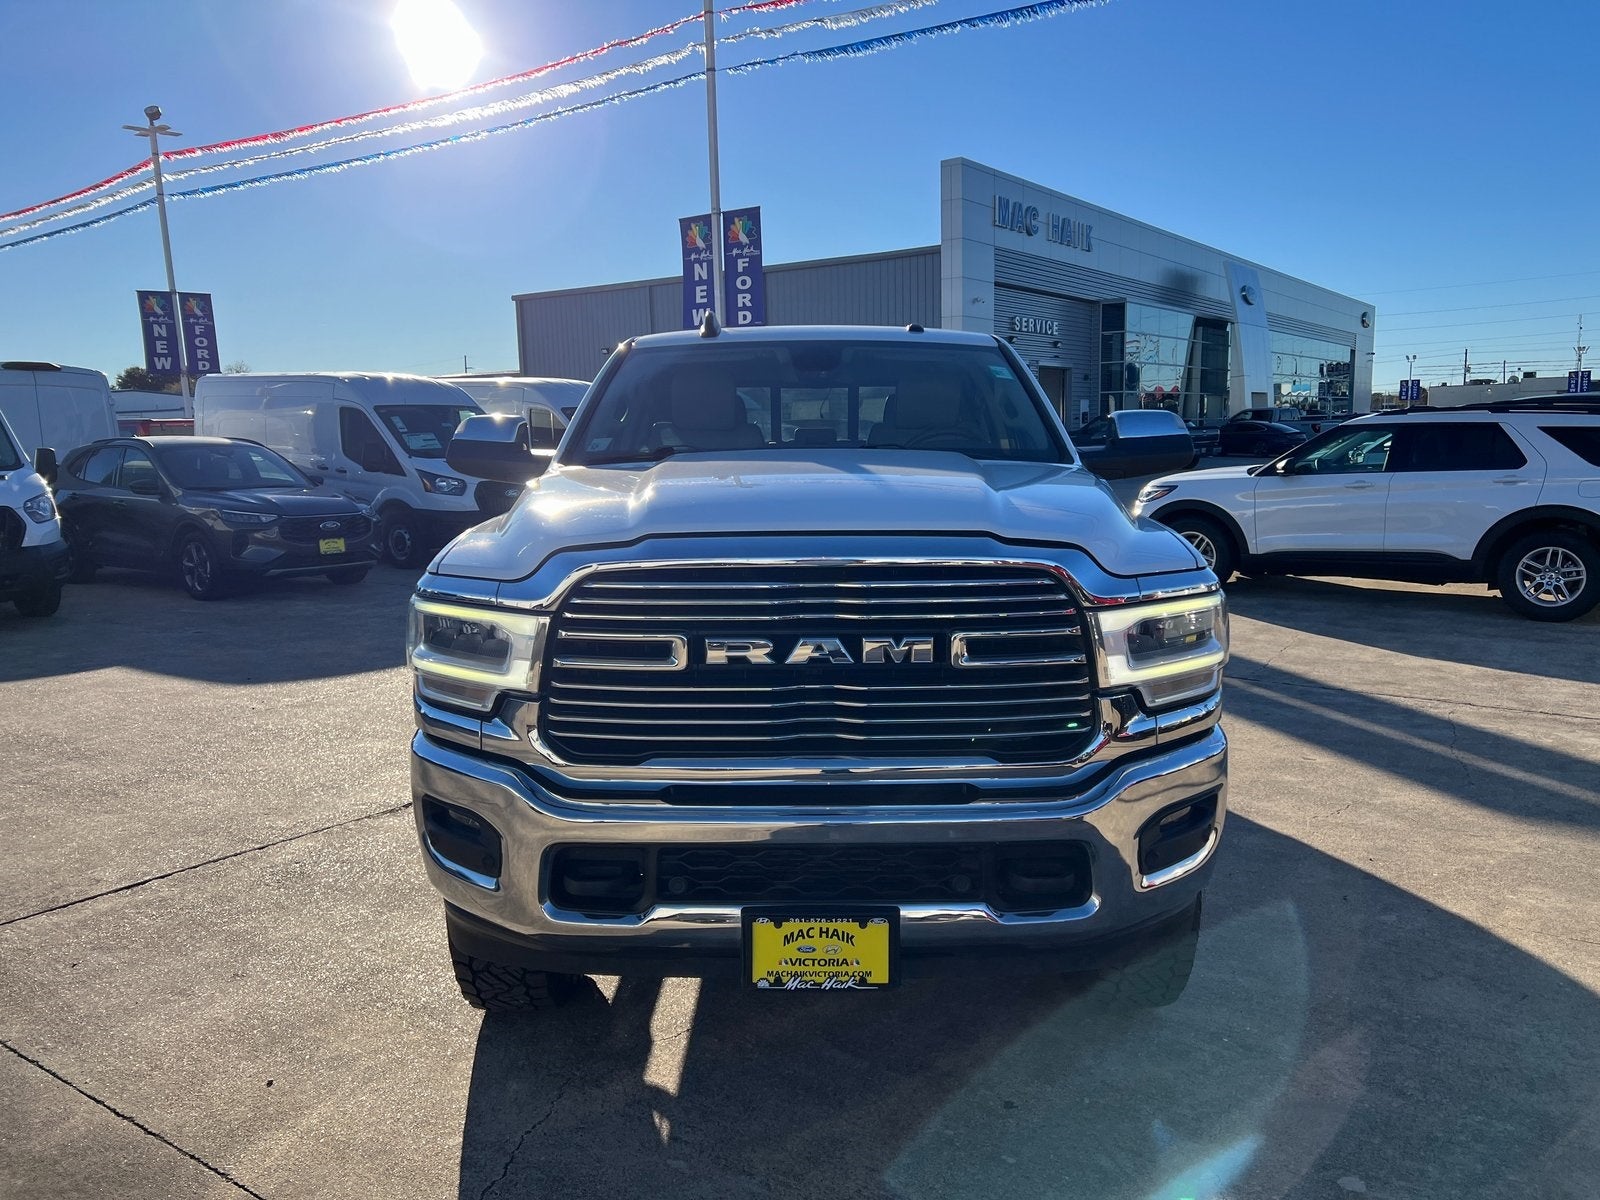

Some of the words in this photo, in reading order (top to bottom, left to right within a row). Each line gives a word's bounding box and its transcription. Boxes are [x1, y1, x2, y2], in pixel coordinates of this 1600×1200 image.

[993, 195, 1039, 236] MAC
[1047, 212, 1093, 252] HAIK
[736, 258, 752, 325] FORD
[1014, 316, 1059, 335] SERVICE
[152, 324, 172, 370] NEW
[194, 325, 211, 371] FORD
[705, 637, 934, 664] RAM
[783, 927, 815, 947] MAC
[819, 927, 856, 947] HAIK
[767, 970, 872, 978] MACHAIKVICTORIA.COM
[789, 958, 849, 967] VICTORIA
[784, 977, 818, 990] Mac
[821, 976, 858, 990] Haik
